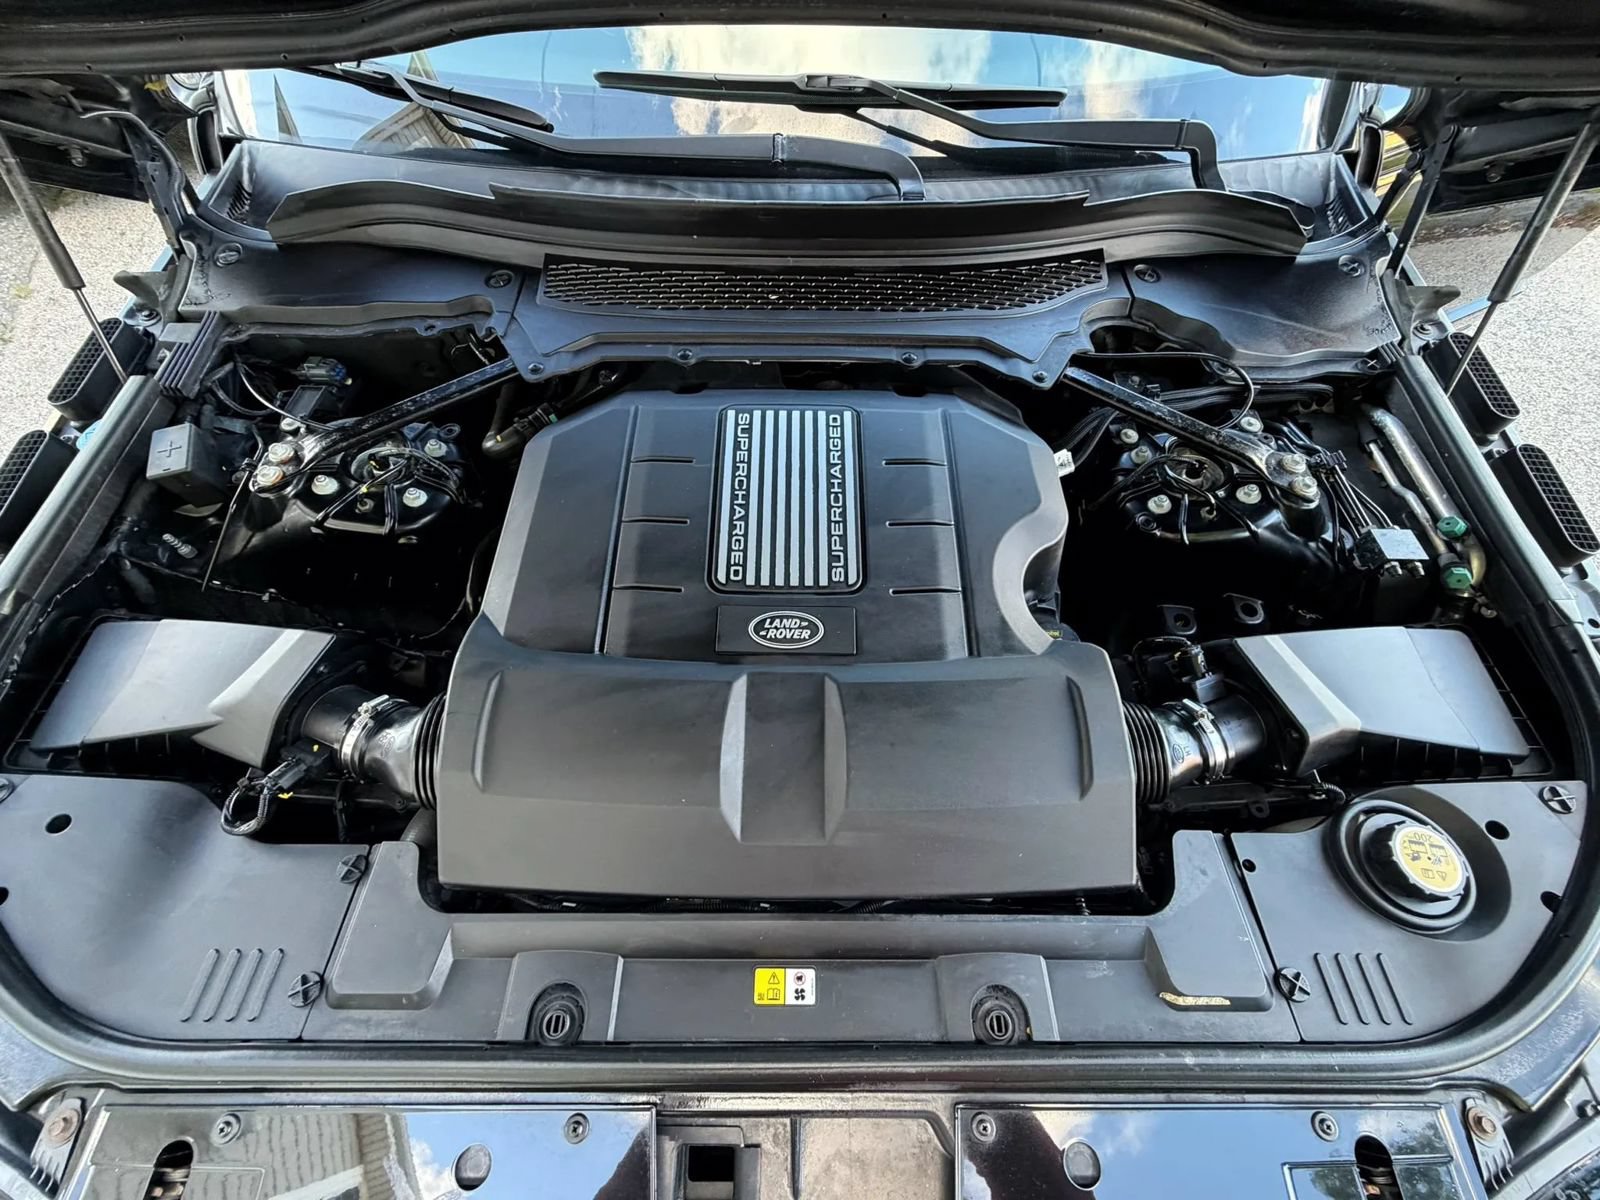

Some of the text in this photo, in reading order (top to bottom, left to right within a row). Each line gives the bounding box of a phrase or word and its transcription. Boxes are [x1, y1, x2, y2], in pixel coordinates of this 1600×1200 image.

[730, 413, 750, 581] SUPERCHARGED
[829, 414, 845, 582] SUPERCHARGED
[764, 618, 801, 630] LAND
[766, 628, 811, 640] ROVER
